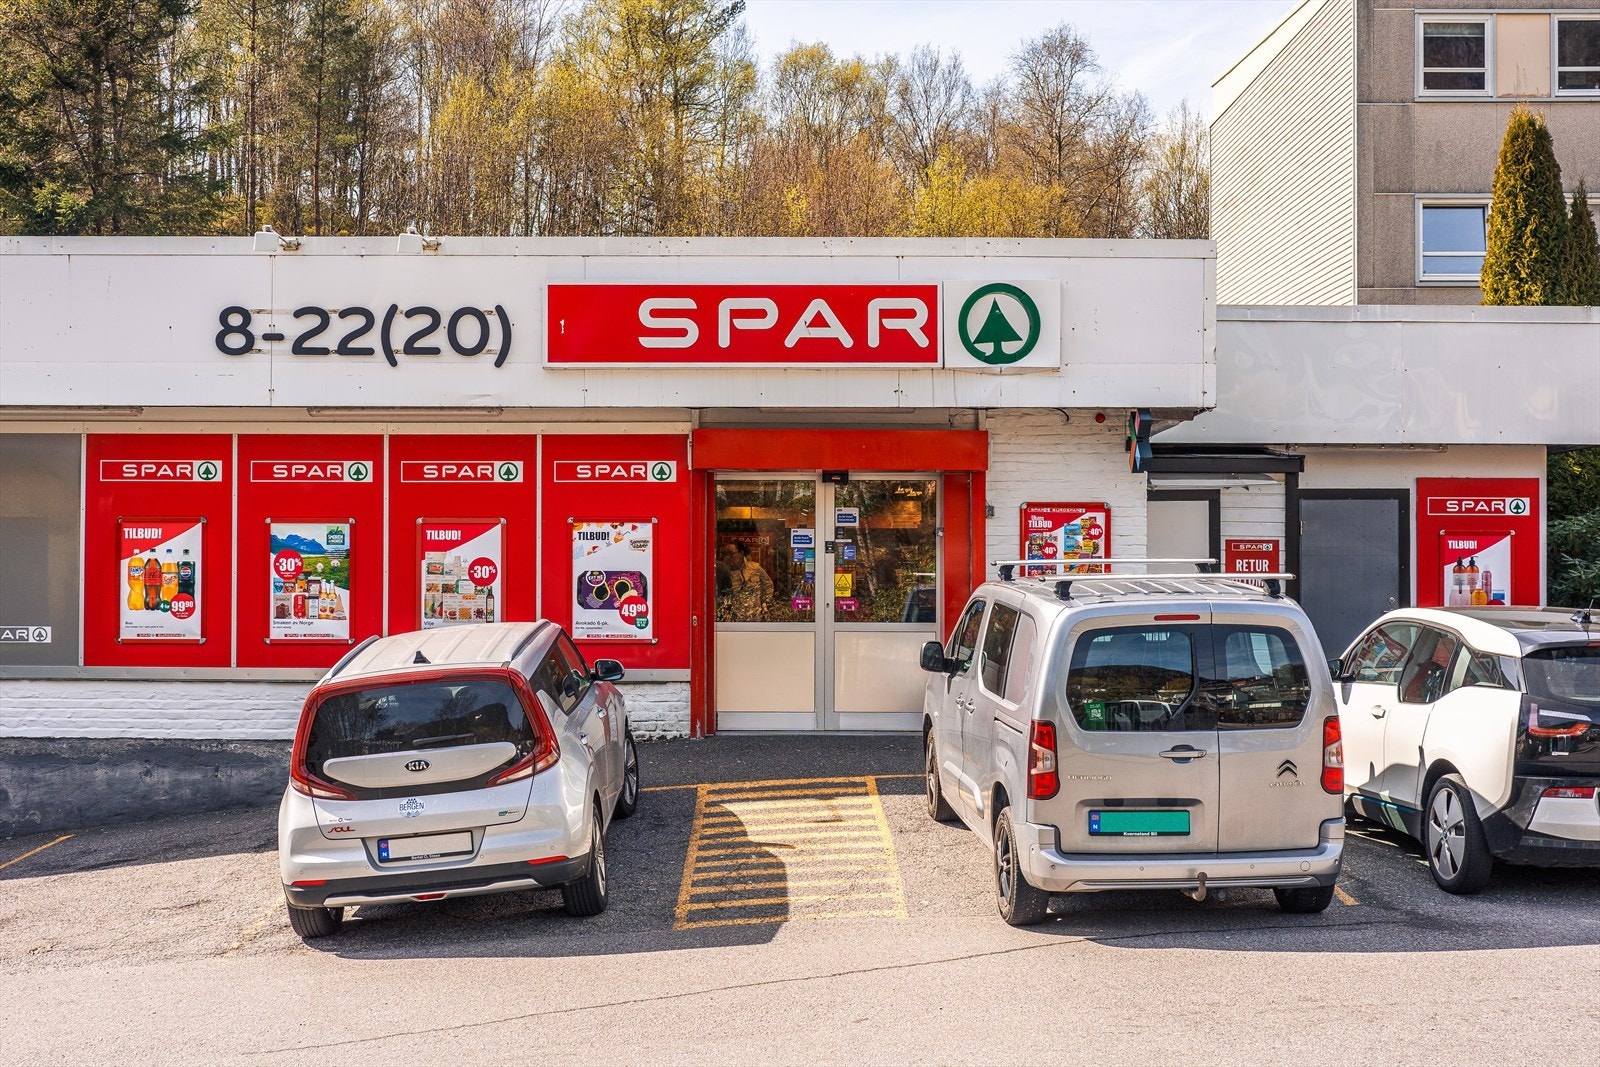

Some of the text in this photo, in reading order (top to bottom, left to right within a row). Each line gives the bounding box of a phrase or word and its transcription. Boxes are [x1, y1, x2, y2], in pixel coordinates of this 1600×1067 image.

[637, 296, 930, 349] SPAR
[215, 303, 512, 368] 8-22(20)
[122, 463, 192, 477] SPAR
[272, 464, 343, 478] SPAR
[423, 465, 493, 478] SPAR
[576, 464, 646, 478] SPAR
[1446, 500, 1505, 512] SPAR
[1028, 520, 1052, 528] TILBUD
[123, 527, 162, 539] TILBUD!
[426, 530, 461, 540] TILBUD!
[577, 532, 610, 541] TILBUD!
[1447, 540, 1478, 549] TILBUD!
[275, 558, 302, 571] -30%
[1236, 559, 1269, 572] RETUR
[470, 565, 496, 578] -30%
[408, 761, 427, 771] KIA
[399, 802, 424, 812] BERGEN
